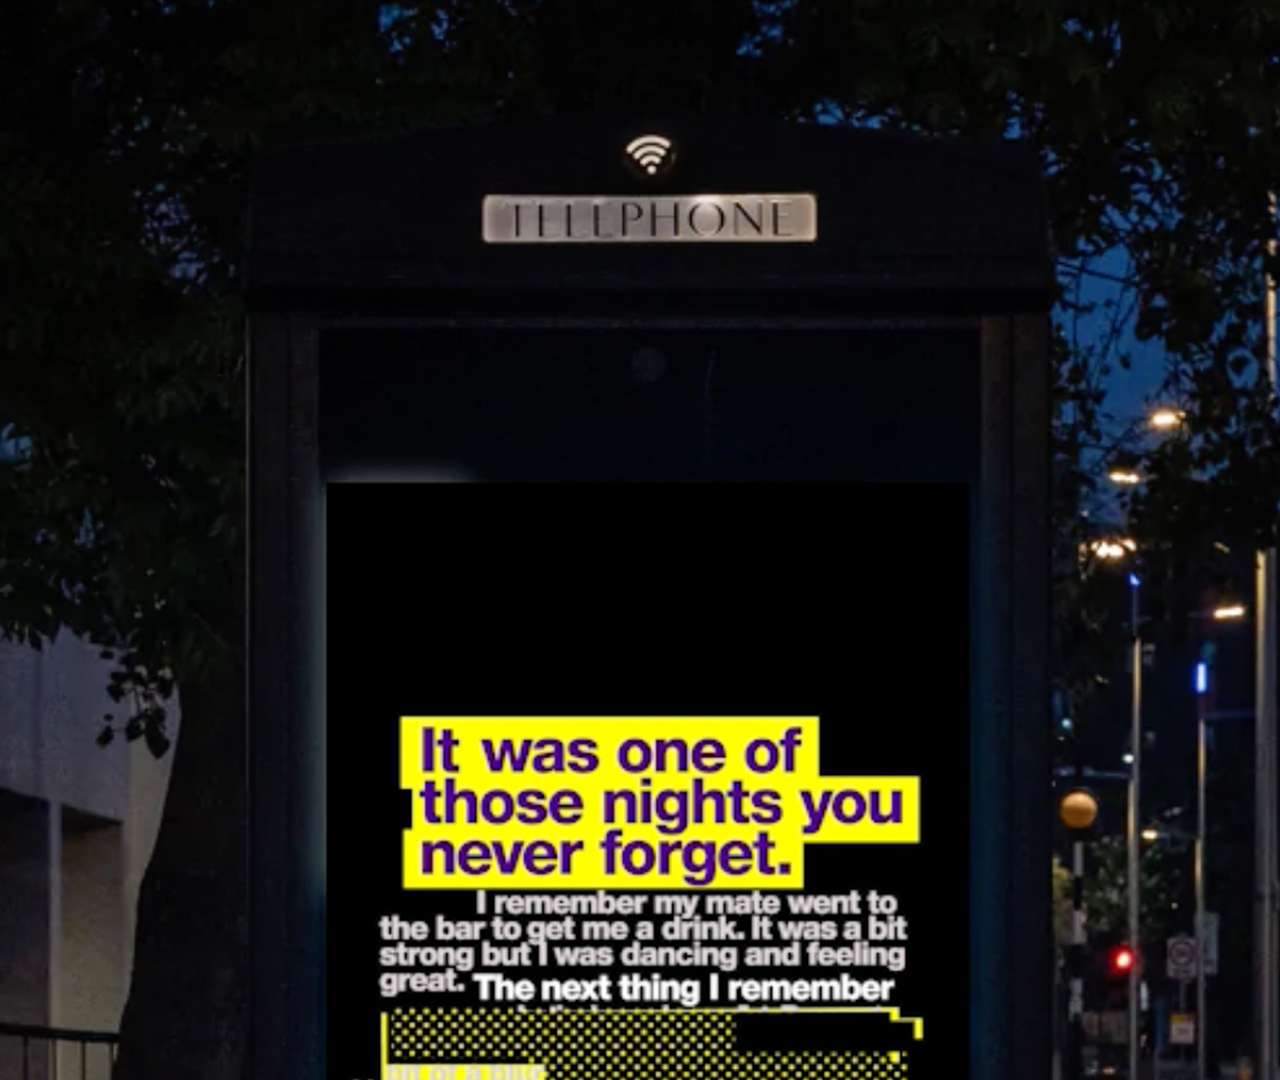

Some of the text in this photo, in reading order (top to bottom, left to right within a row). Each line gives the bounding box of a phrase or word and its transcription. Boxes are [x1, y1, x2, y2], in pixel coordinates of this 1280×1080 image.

[504, 202, 794, 237] TELEPHONE
[423, 727, 802, 774] It was one of
[420, 779, 903, 835] those nights you
[422, 832, 791, 887] never forget.
[476, 889, 898, 919] I remember my mate went to
[378, 915, 908, 946] the bar to get me a drink. It was a bit
[379, 942, 906, 972] strong but I was dancing and feeling
[378, 969, 896, 1007] great. The next thing I remember
